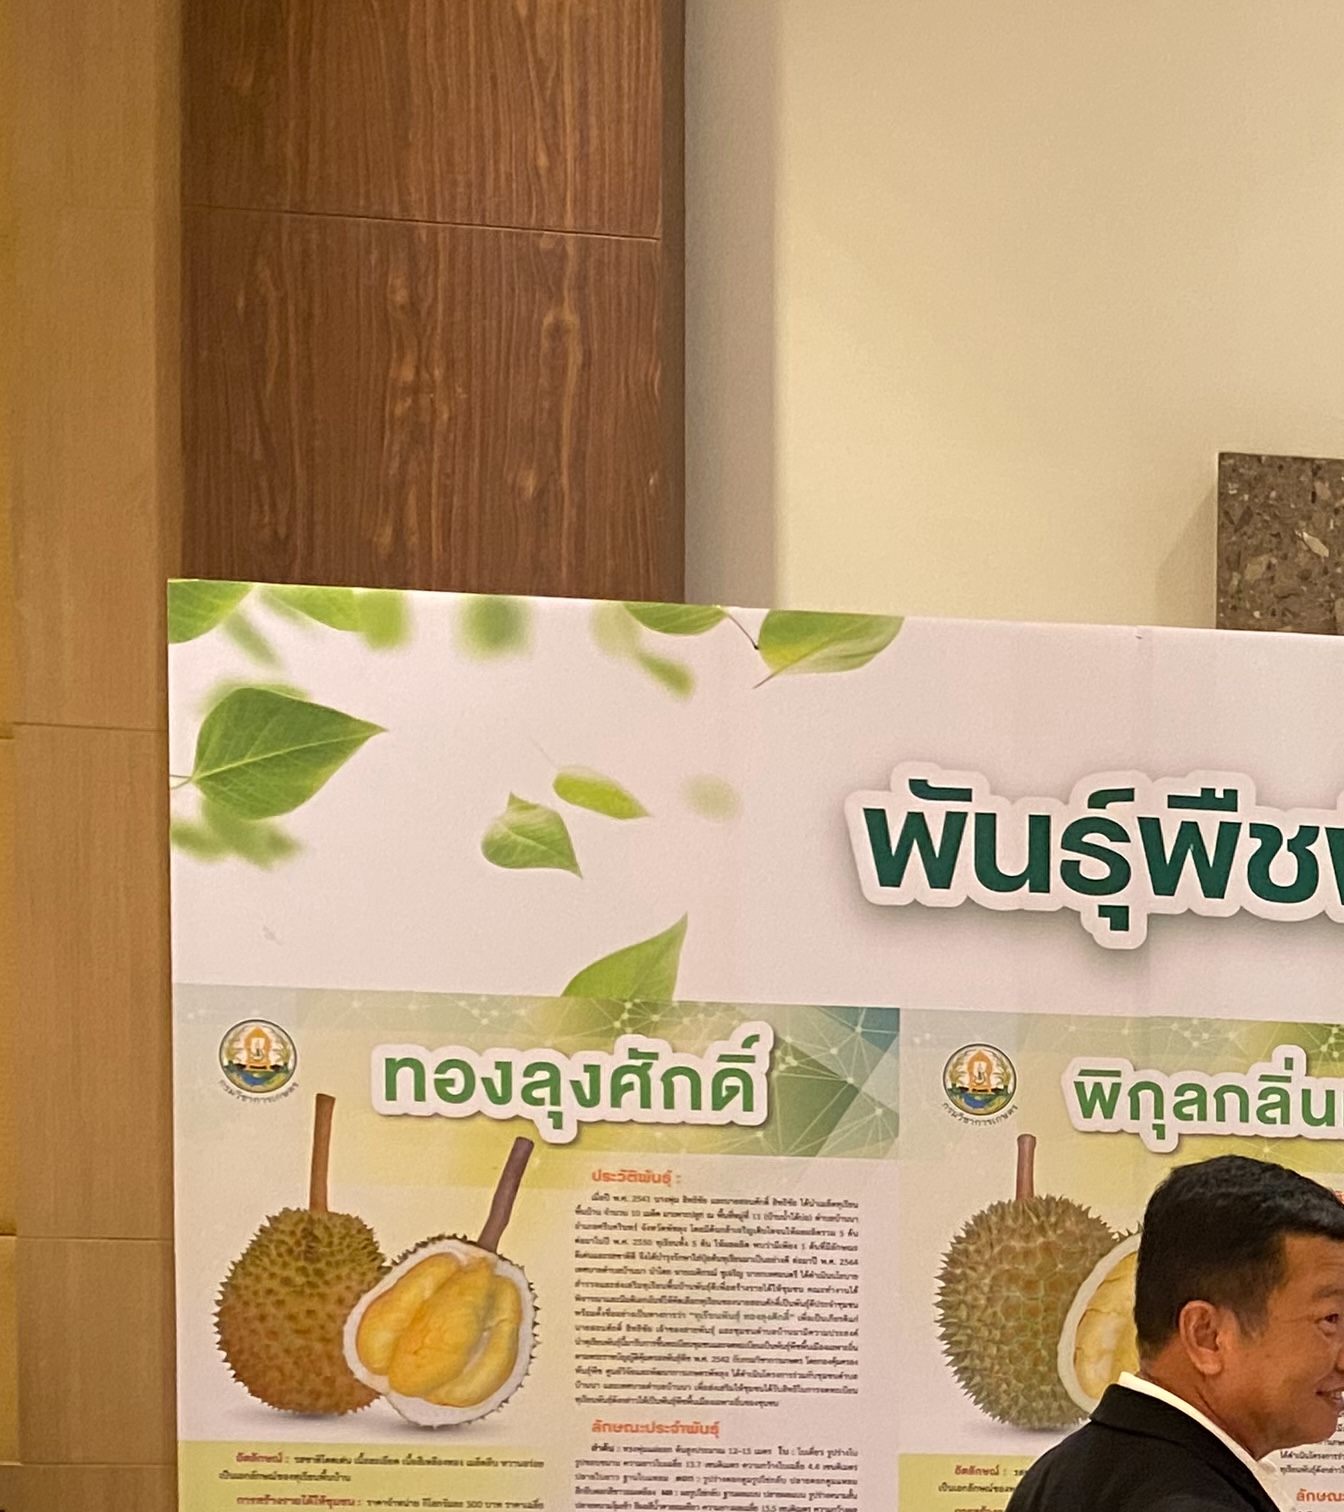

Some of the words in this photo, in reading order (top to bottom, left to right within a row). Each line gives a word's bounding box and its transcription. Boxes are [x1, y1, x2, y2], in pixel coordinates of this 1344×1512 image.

[384, 1033, 760, 1130] ทองลุงศักดิ์
[592, 1169, 672, 1187] ประวัติพันธุ์
[591, 1419, 720, 1438] ลักษณะประจำพันธุ์
